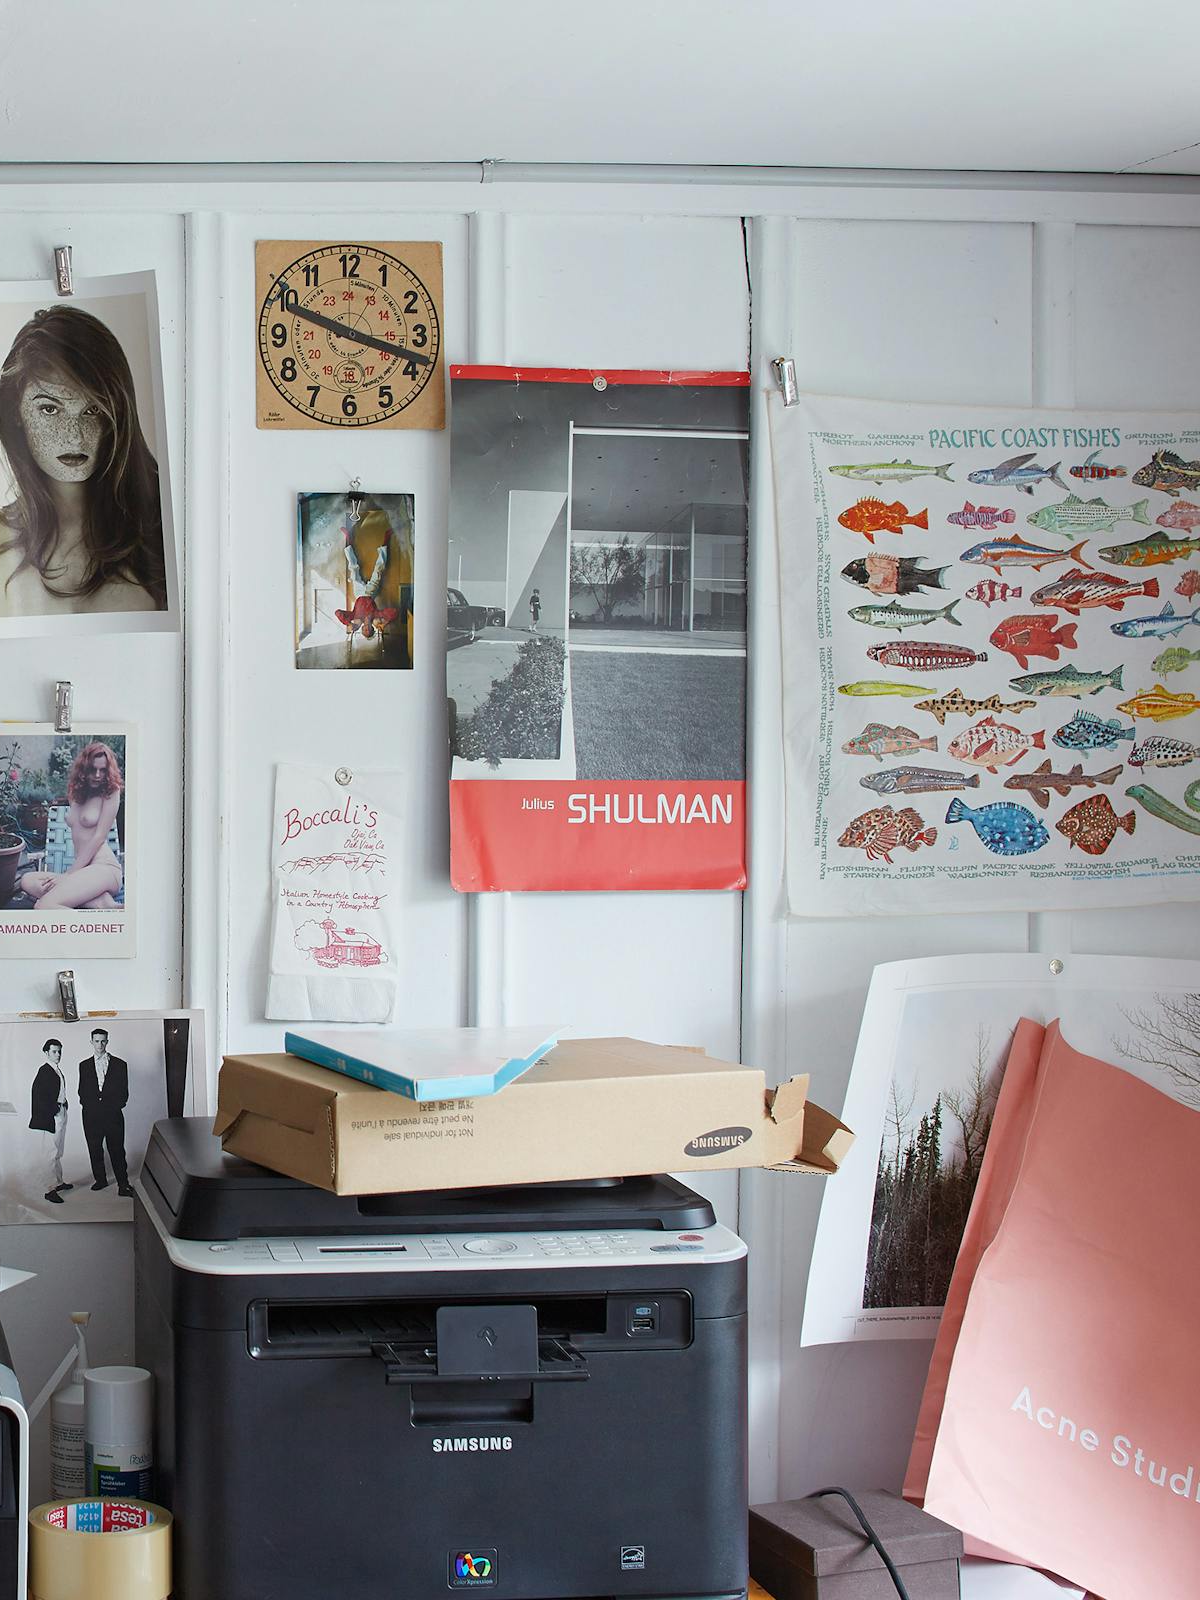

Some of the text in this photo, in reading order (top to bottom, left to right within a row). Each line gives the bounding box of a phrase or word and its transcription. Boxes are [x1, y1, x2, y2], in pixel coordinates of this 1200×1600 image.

[339, 255, 360, 278] 12
[302, 265, 319, 286] 11
[378, 265, 387, 286] 1
[280, 289, 298, 312] 10
[323, 296, 336, 306] 23
[342, 291, 354, 300] 24
[366, 296, 376, 306] 13
[404, 291, 418, 313] 2
[378, 310, 390, 320] 14
[271, 323, 287, 348] 9
[304, 332, 314, 340] 21
[385, 332, 396, 340] 15
[412, 324, 427, 348] 3
[308, 350, 320, 359] 20
[280, 357, 297, 382] 8
[322, 366, 332, 375] 19
[343, 372, 354, 380] 18
[365, 366, 374, 376] 17
[403, 360, 419, 381] 4
[307, 386, 321, 408] 7
[378, 386, 394, 408] 5
[342, 394, 357, 417] 6
[928, 427, 1121, 449] PACIFIC COAST FISHES
[521, 793, 733, 824] Julius SHULMAN
[281, 796, 378, 846] Boccali's
[51, 924, 66, 934] DE
[70, 924, 124, 934] CADENET
[386, 1118, 420, 1128] revendu
[441, 1114, 460, 1125] peut
[462, 1114, 474, 1124] Ne
[384, 1128, 474, 1141] Not for individual sale
[692, 1135, 744, 1149] SAMSUNG
[1010, 1385, 1100, 1452] Acne
[432, 1436, 513, 1452] SAMSUNG
[78, 1512, 100, 1521] 4124
[110, 1509, 144, 1527] tesa
